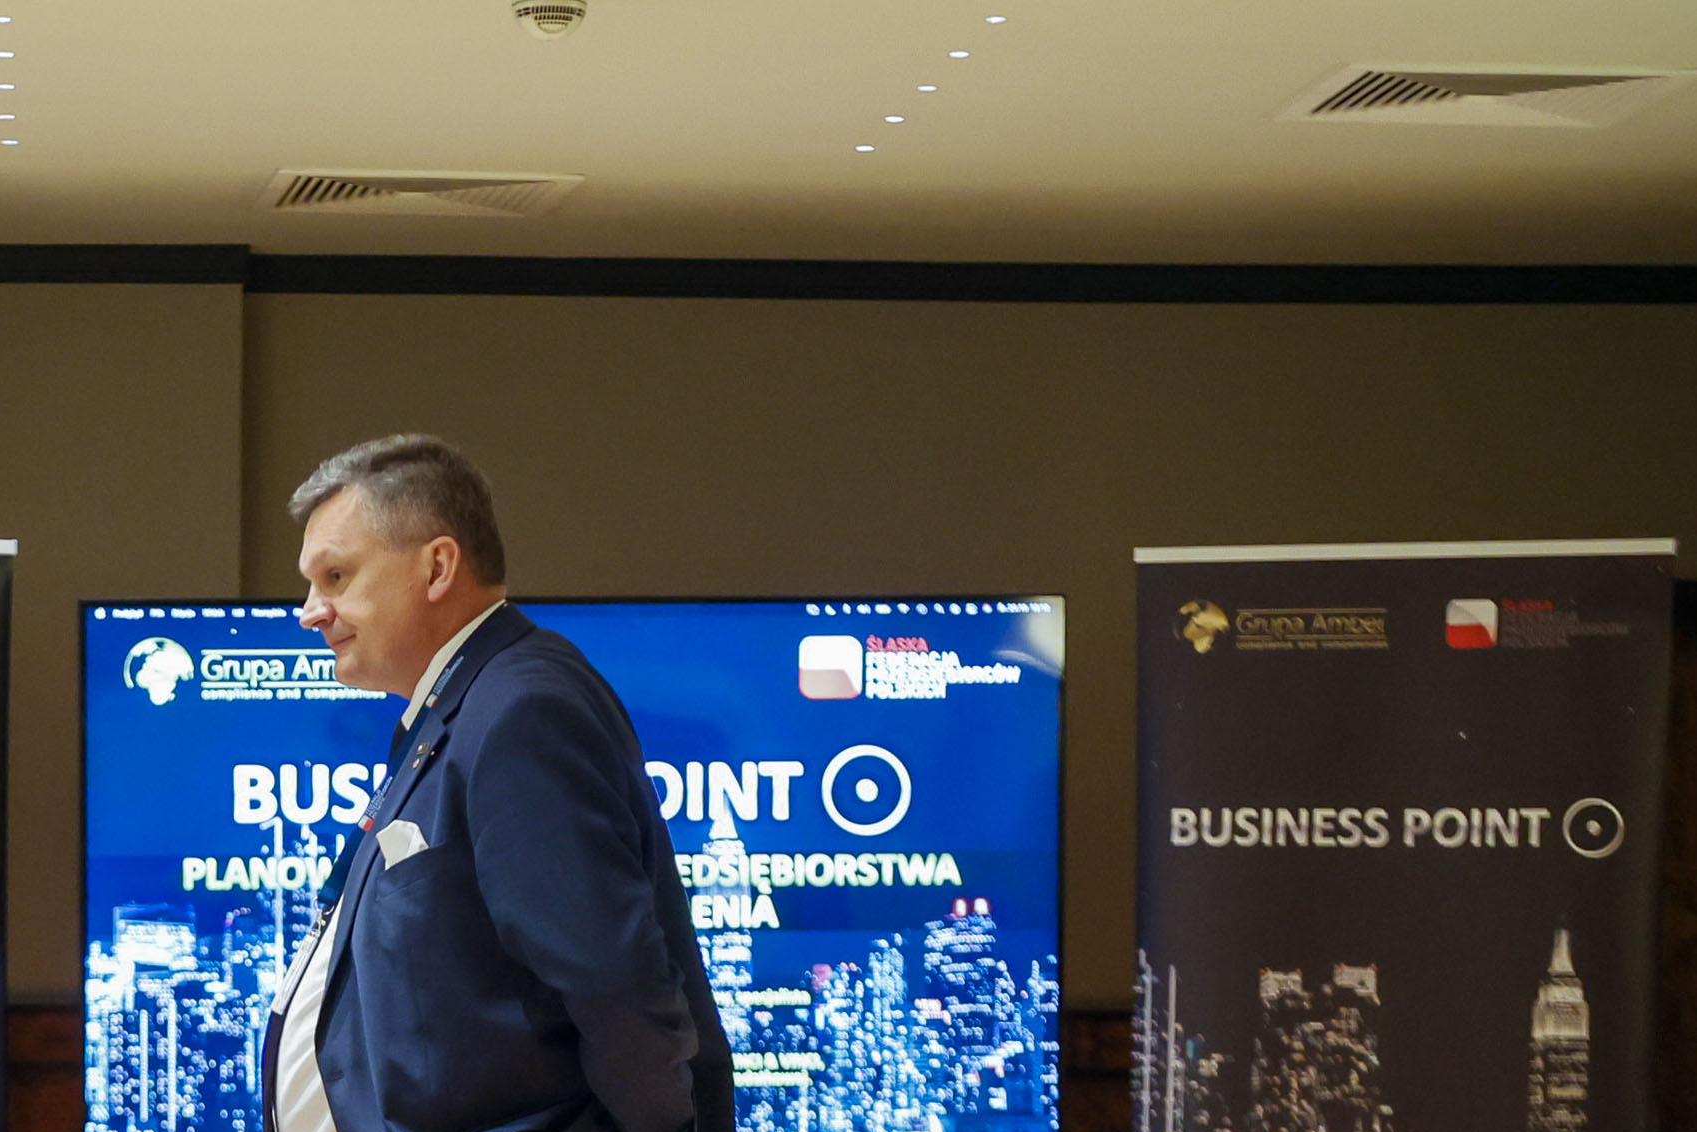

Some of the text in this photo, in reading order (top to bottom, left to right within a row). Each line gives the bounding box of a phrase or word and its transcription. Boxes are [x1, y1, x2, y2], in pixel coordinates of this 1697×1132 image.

[200, 654, 286, 688] Grupa
[1170, 806, 1551, 848] BUSINESS POINT
